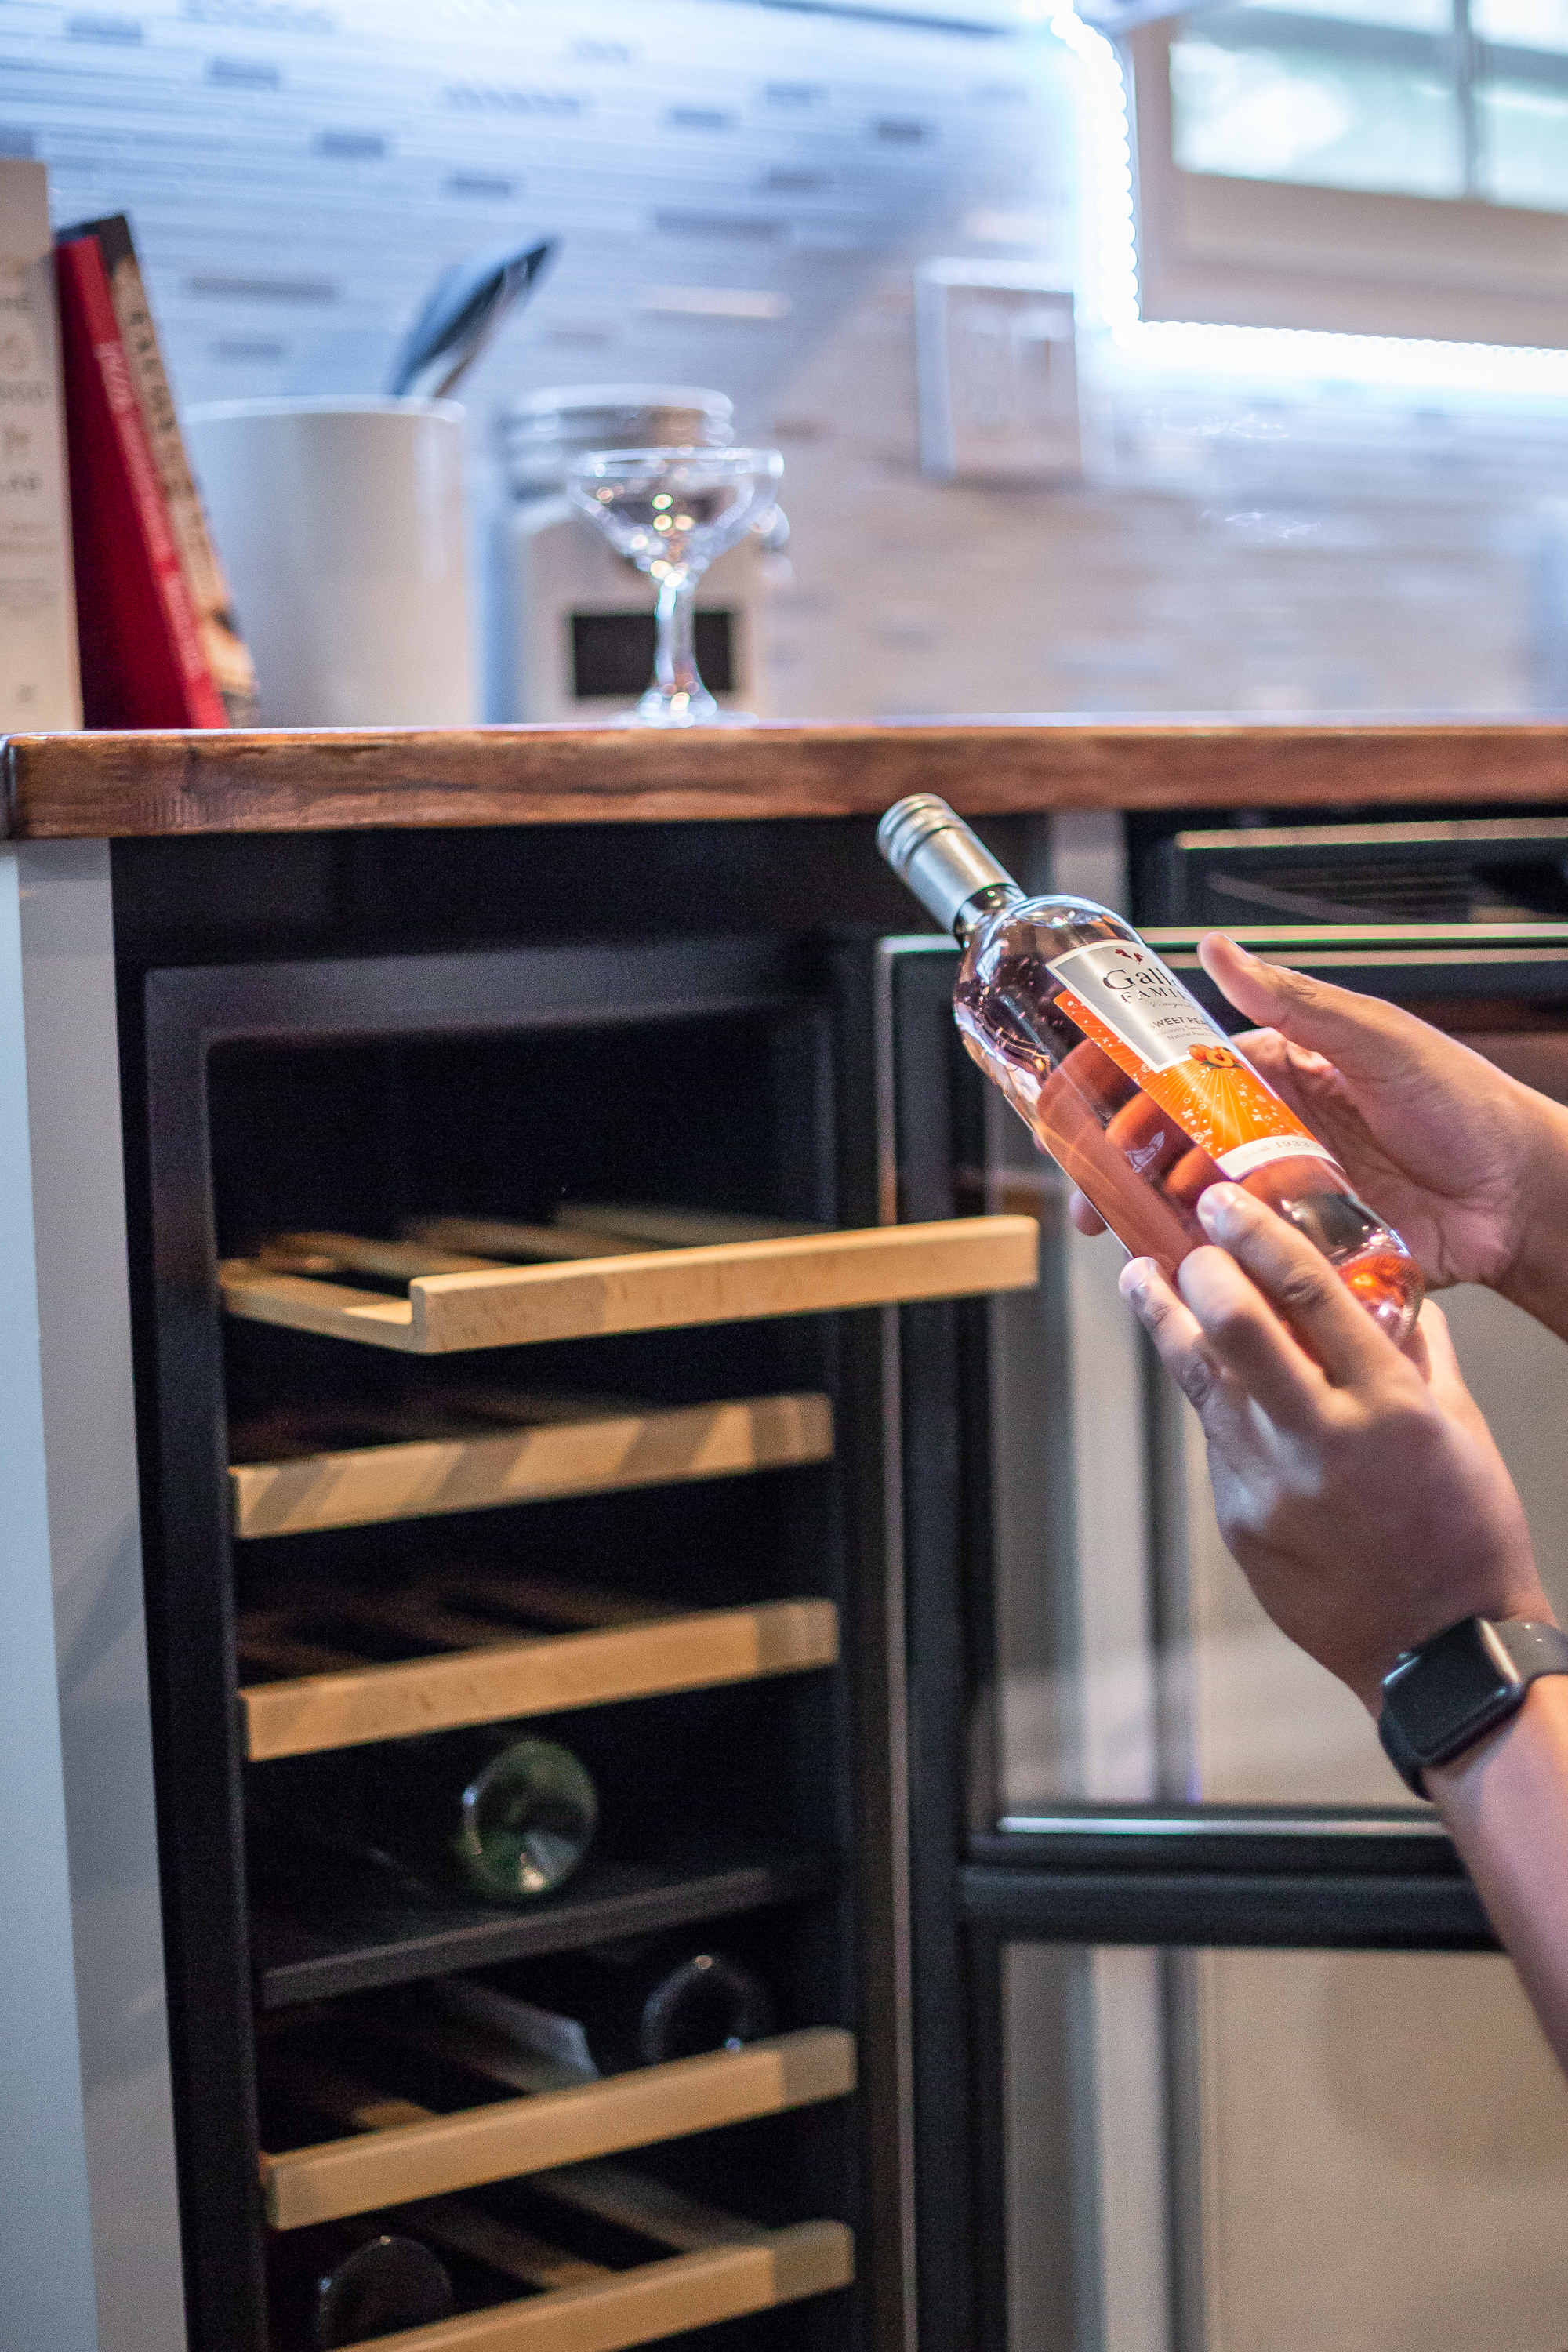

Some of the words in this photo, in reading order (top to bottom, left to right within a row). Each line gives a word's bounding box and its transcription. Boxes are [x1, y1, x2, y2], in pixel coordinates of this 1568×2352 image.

[1120, 987, 1191, 1004] FAMIL
[1147, 1017, 1185, 1029] SWEET
[1186, 1017, 1210, 1026] PEA
[1274, 1140, 1310, 1149] 1933
